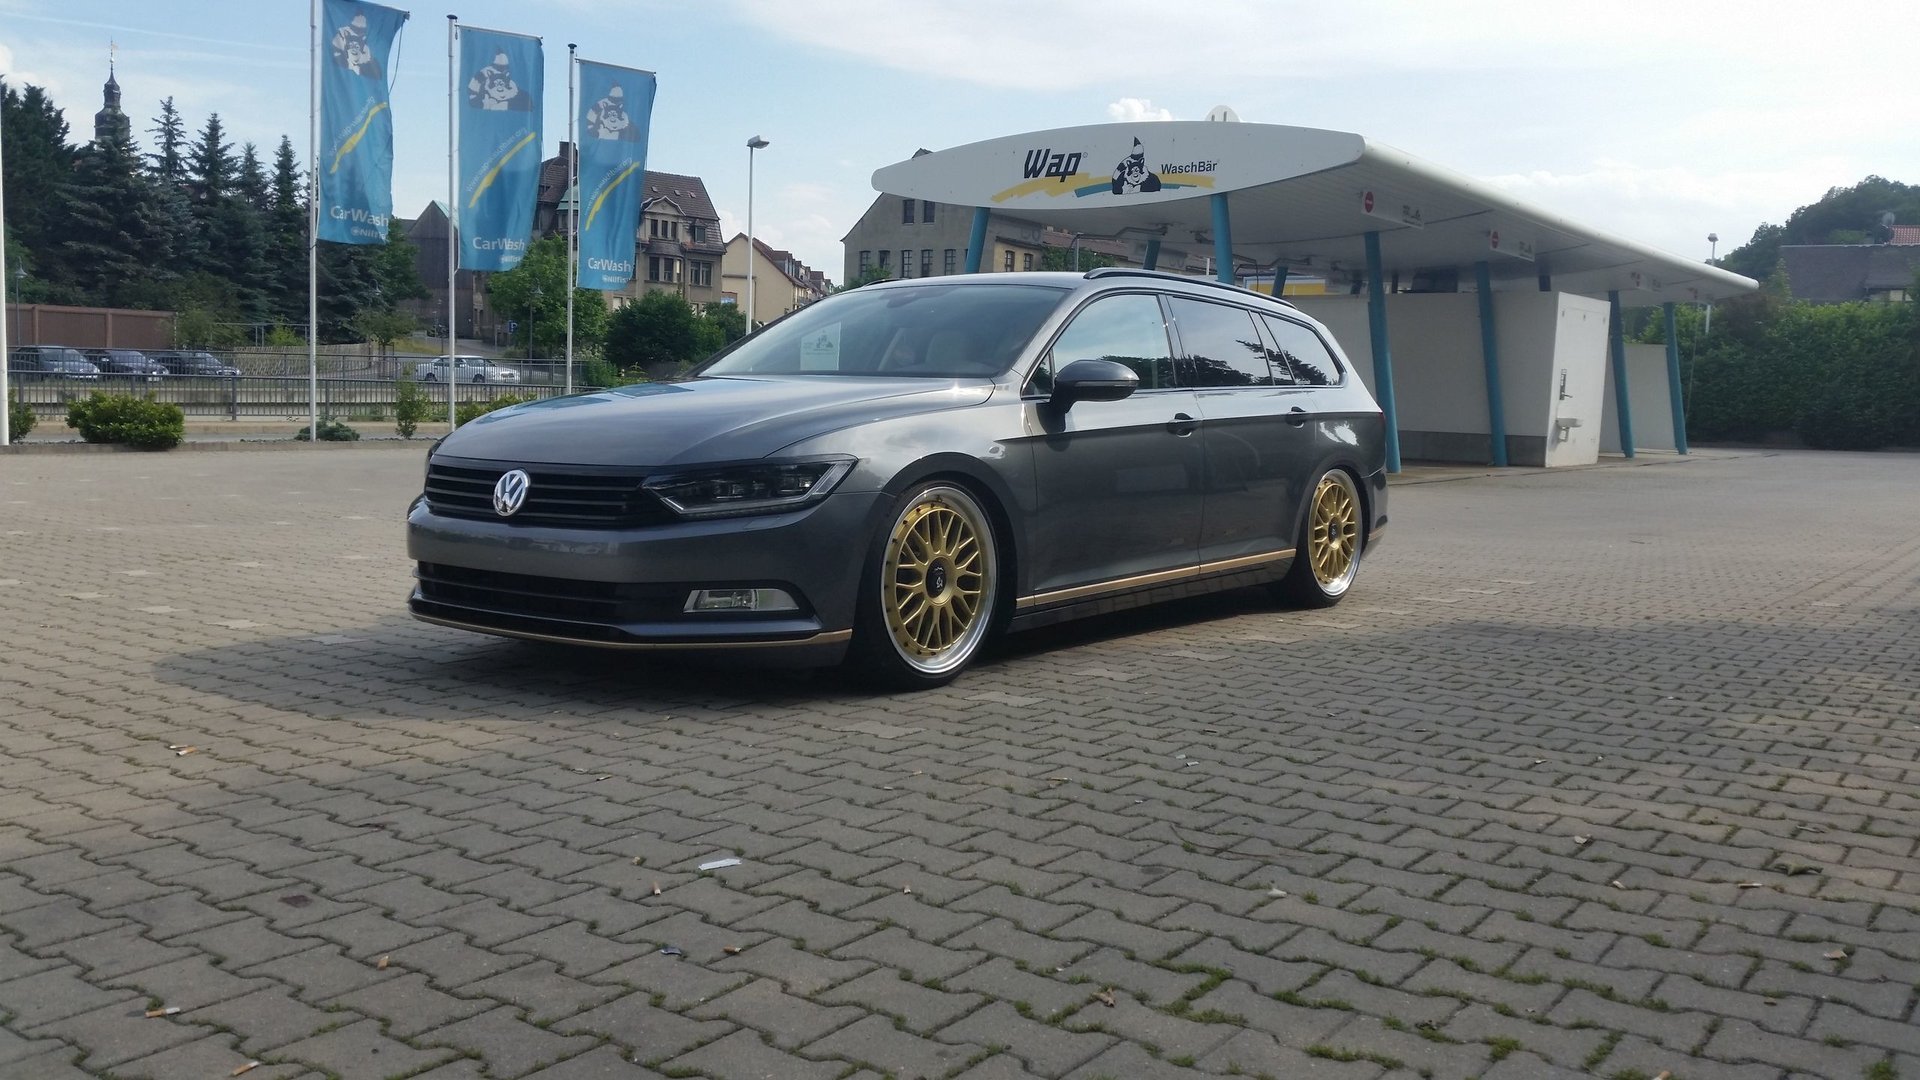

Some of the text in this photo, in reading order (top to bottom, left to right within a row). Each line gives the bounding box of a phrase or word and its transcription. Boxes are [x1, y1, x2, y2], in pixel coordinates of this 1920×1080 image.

[1024, 149, 1082, 182] Wap
[1161, 160, 1218, 175] WaschBär
[331, 205, 389, 226] CarWash
[472, 236, 525, 251] CarWash
[588, 257, 632, 272] CarWash
